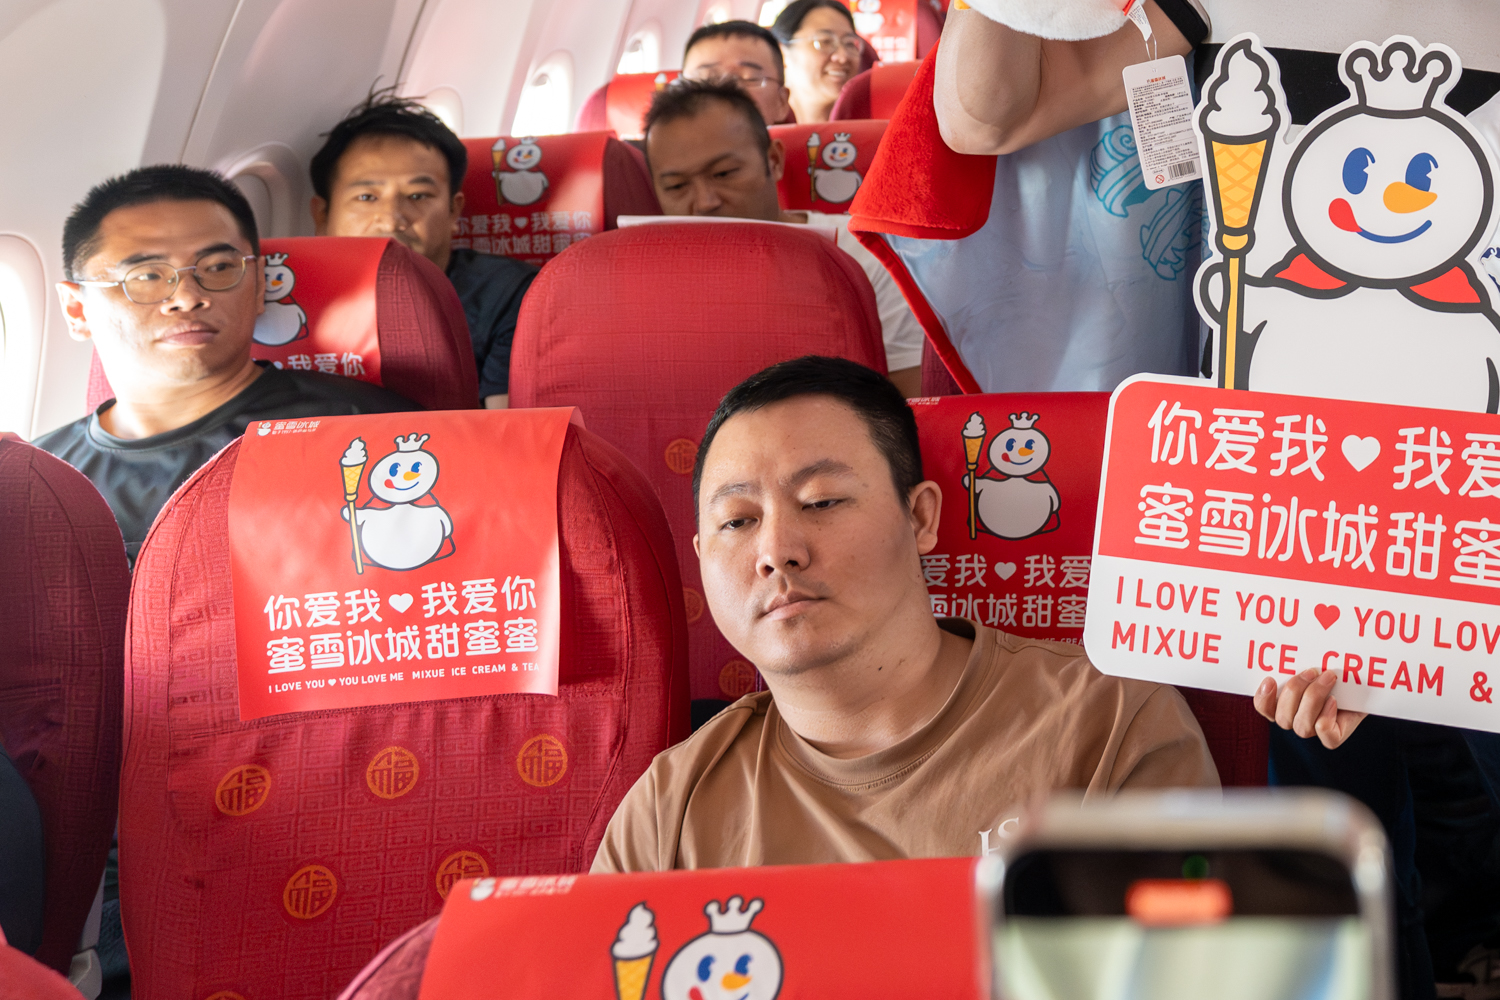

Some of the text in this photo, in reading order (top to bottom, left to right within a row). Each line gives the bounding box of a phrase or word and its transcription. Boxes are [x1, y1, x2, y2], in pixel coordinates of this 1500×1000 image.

[1148, 400, 1328, 482] 你爱我
[264, 575, 537, 632] 你爱我 我爱你
[1116, 576, 1125, 605] I
[1135, 579, 1219, 617] LOVE
[1235, 590, 1300, 629] YOU
[1353, 606, 1421, 645] YOU
[266, 616, 540, 675] 蜜雪冰城甜蜜蜜
[275, 681, 302, 693] LOVE
[305, 679, 326, 690] YOU
[339, 675, 359, 686] YOU
[361, 672, 387, 684] LOVE
[390, 672, 404, 681] ME
[412, 668, 445, 680] MIXUE
[451, 666, 467, 676] ICE
[472, 663, 506, 675] CREAM
[511, 663, 519, 672] &
[522, 662, 540, 672] TEA
[1110, 620, 1221, 664] MIXUE
[1247, 639, 1298, 676] ICE
[1321, 650, 1445, 697] CREAM
[1469, 671, 1494, 704] &
